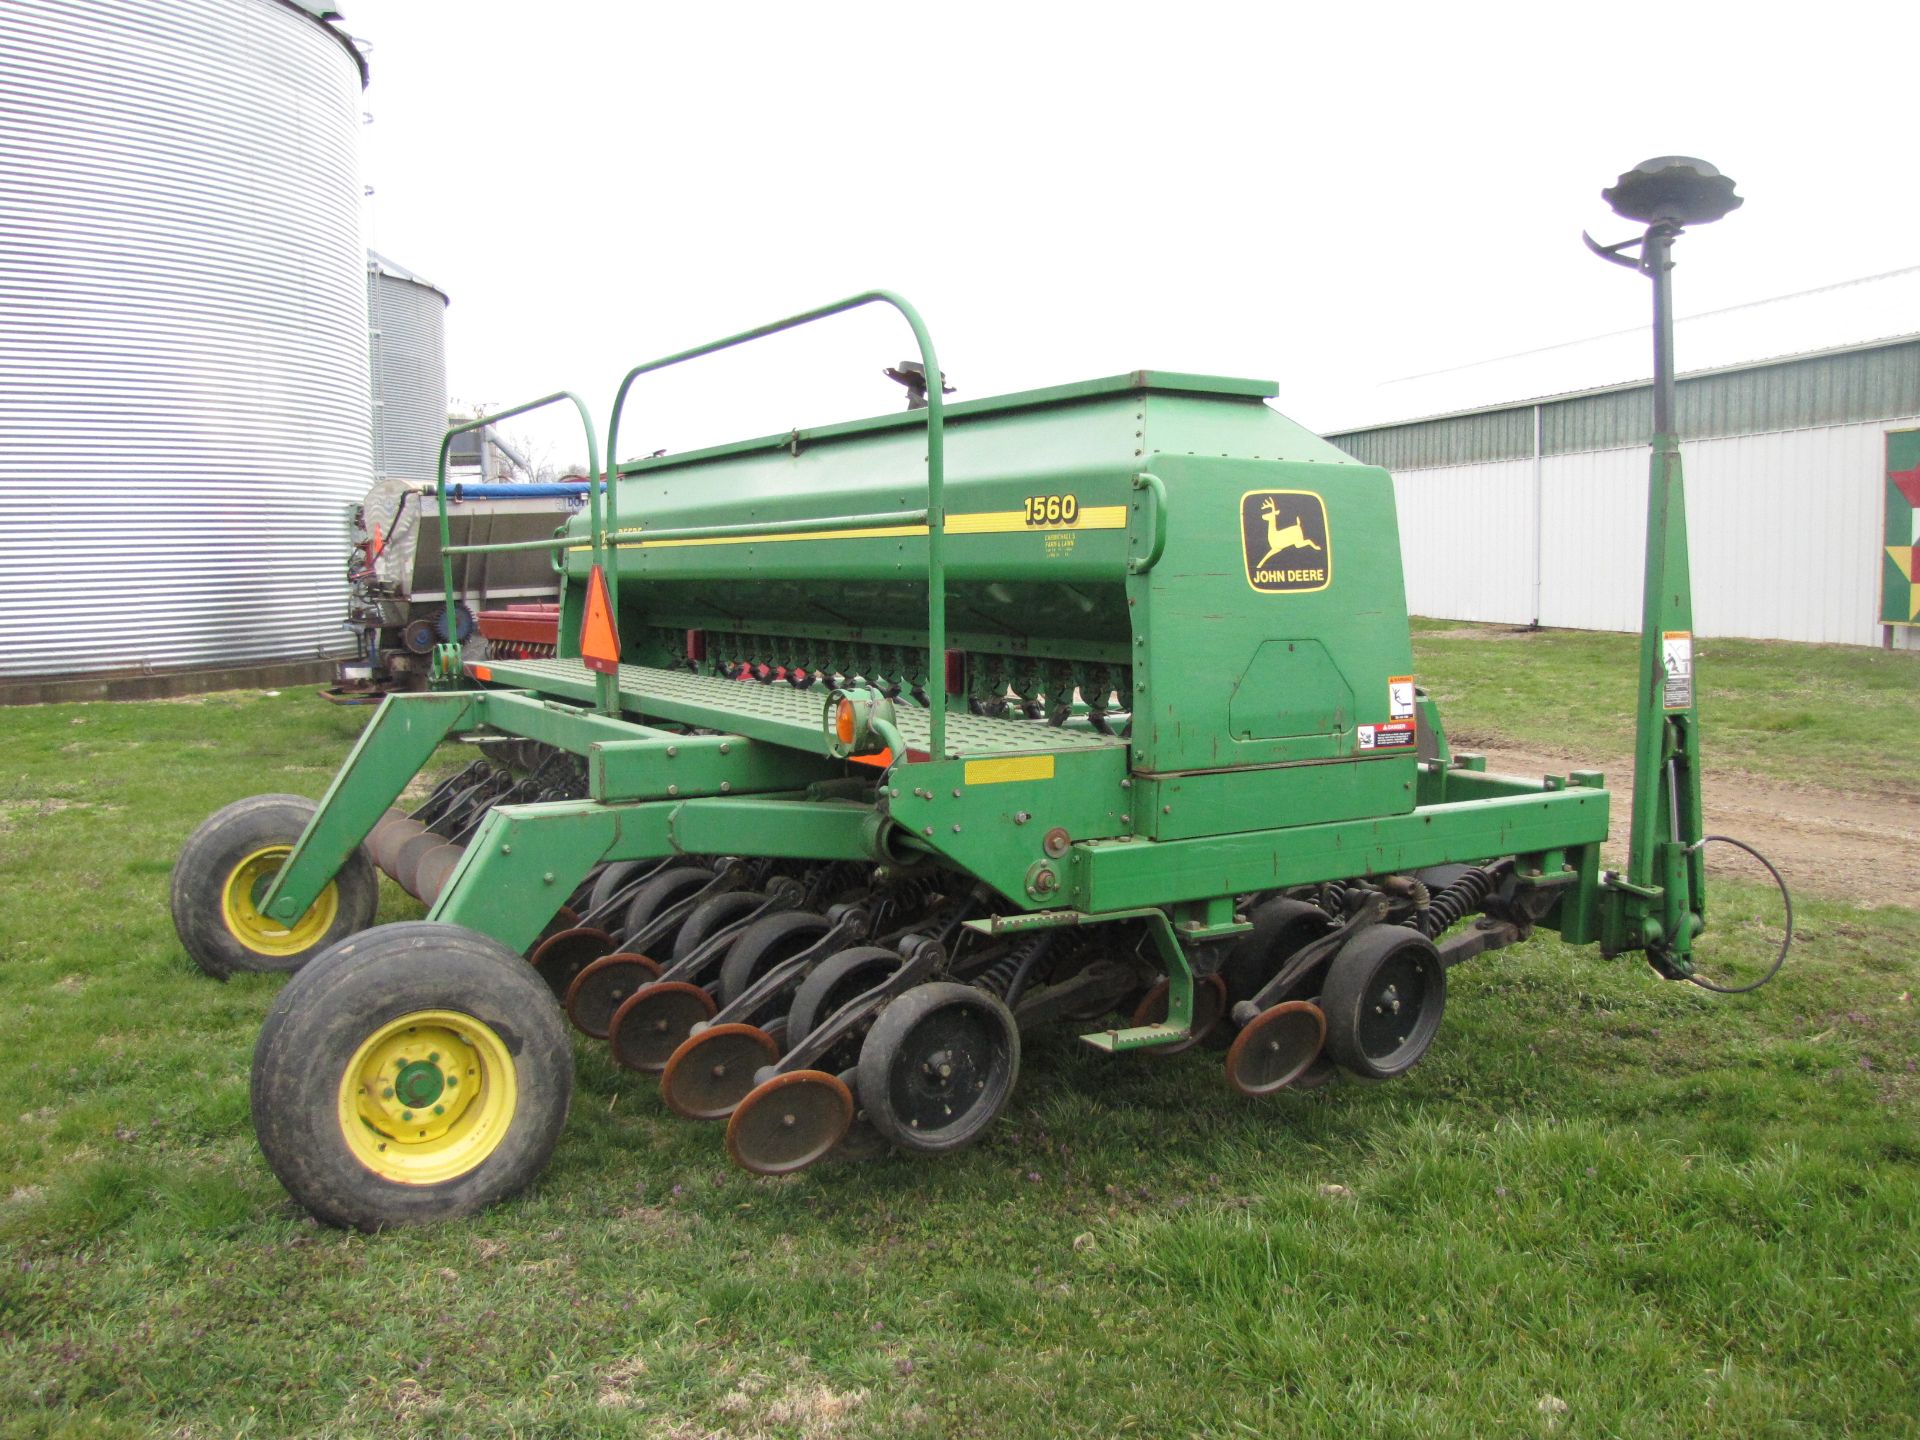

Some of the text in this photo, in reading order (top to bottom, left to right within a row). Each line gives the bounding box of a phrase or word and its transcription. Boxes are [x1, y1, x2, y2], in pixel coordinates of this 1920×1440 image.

[1024, 494, 1078, 524] 1560
[1254, 569, 1324, 583] JOHN DEERE
